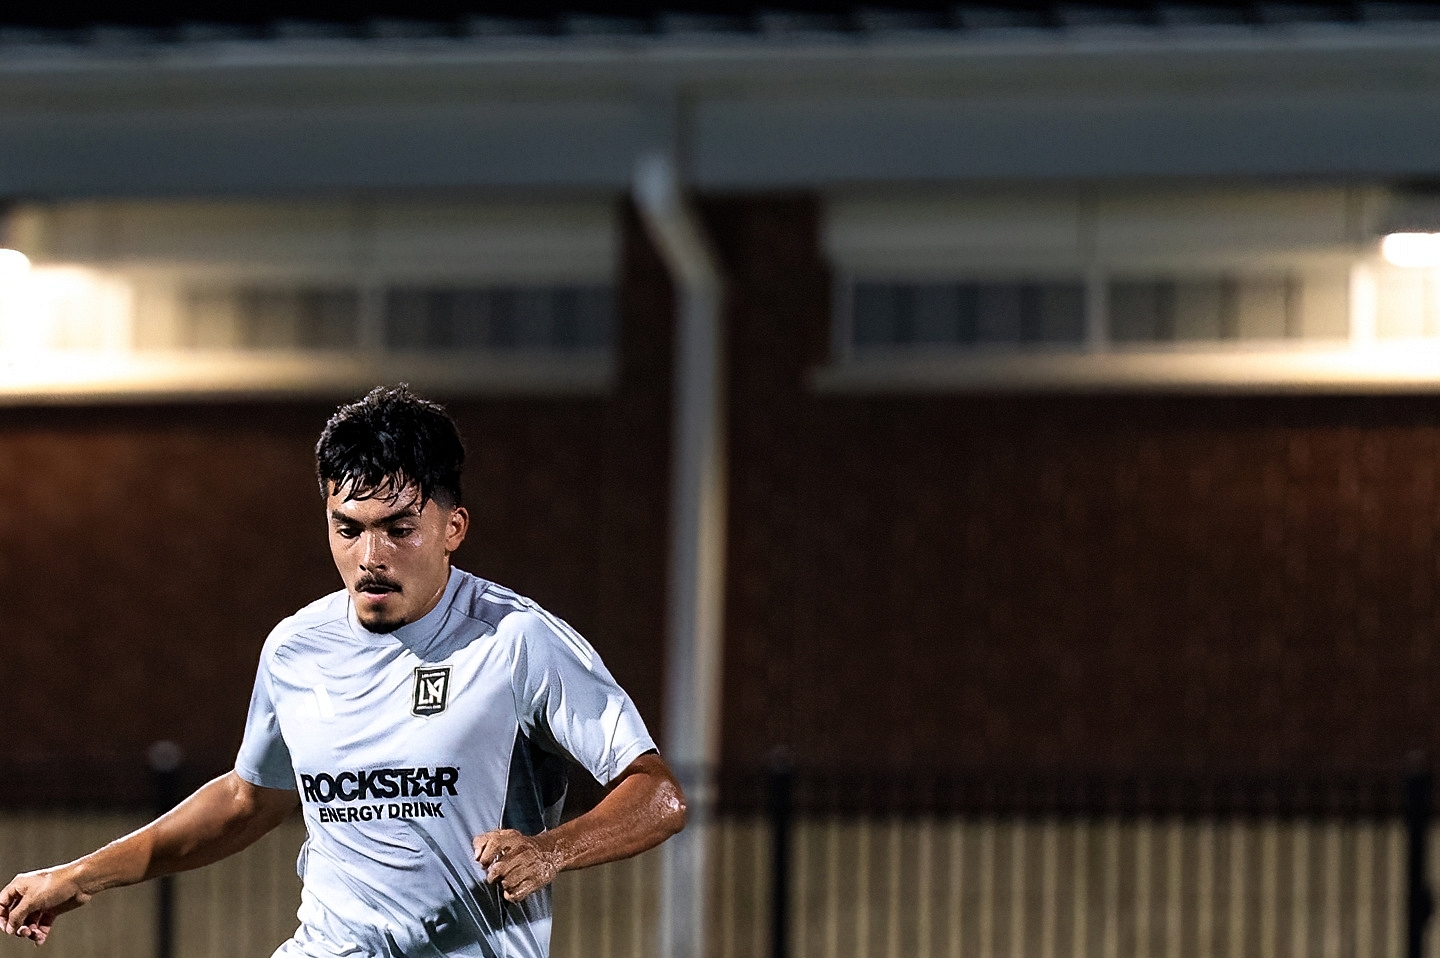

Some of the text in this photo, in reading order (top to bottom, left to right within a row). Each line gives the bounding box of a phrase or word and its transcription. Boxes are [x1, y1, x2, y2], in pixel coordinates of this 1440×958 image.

[301, 767, 458, 803] ROCKSTAR
[319, 803, 444, 822] ENERGY DRINK
